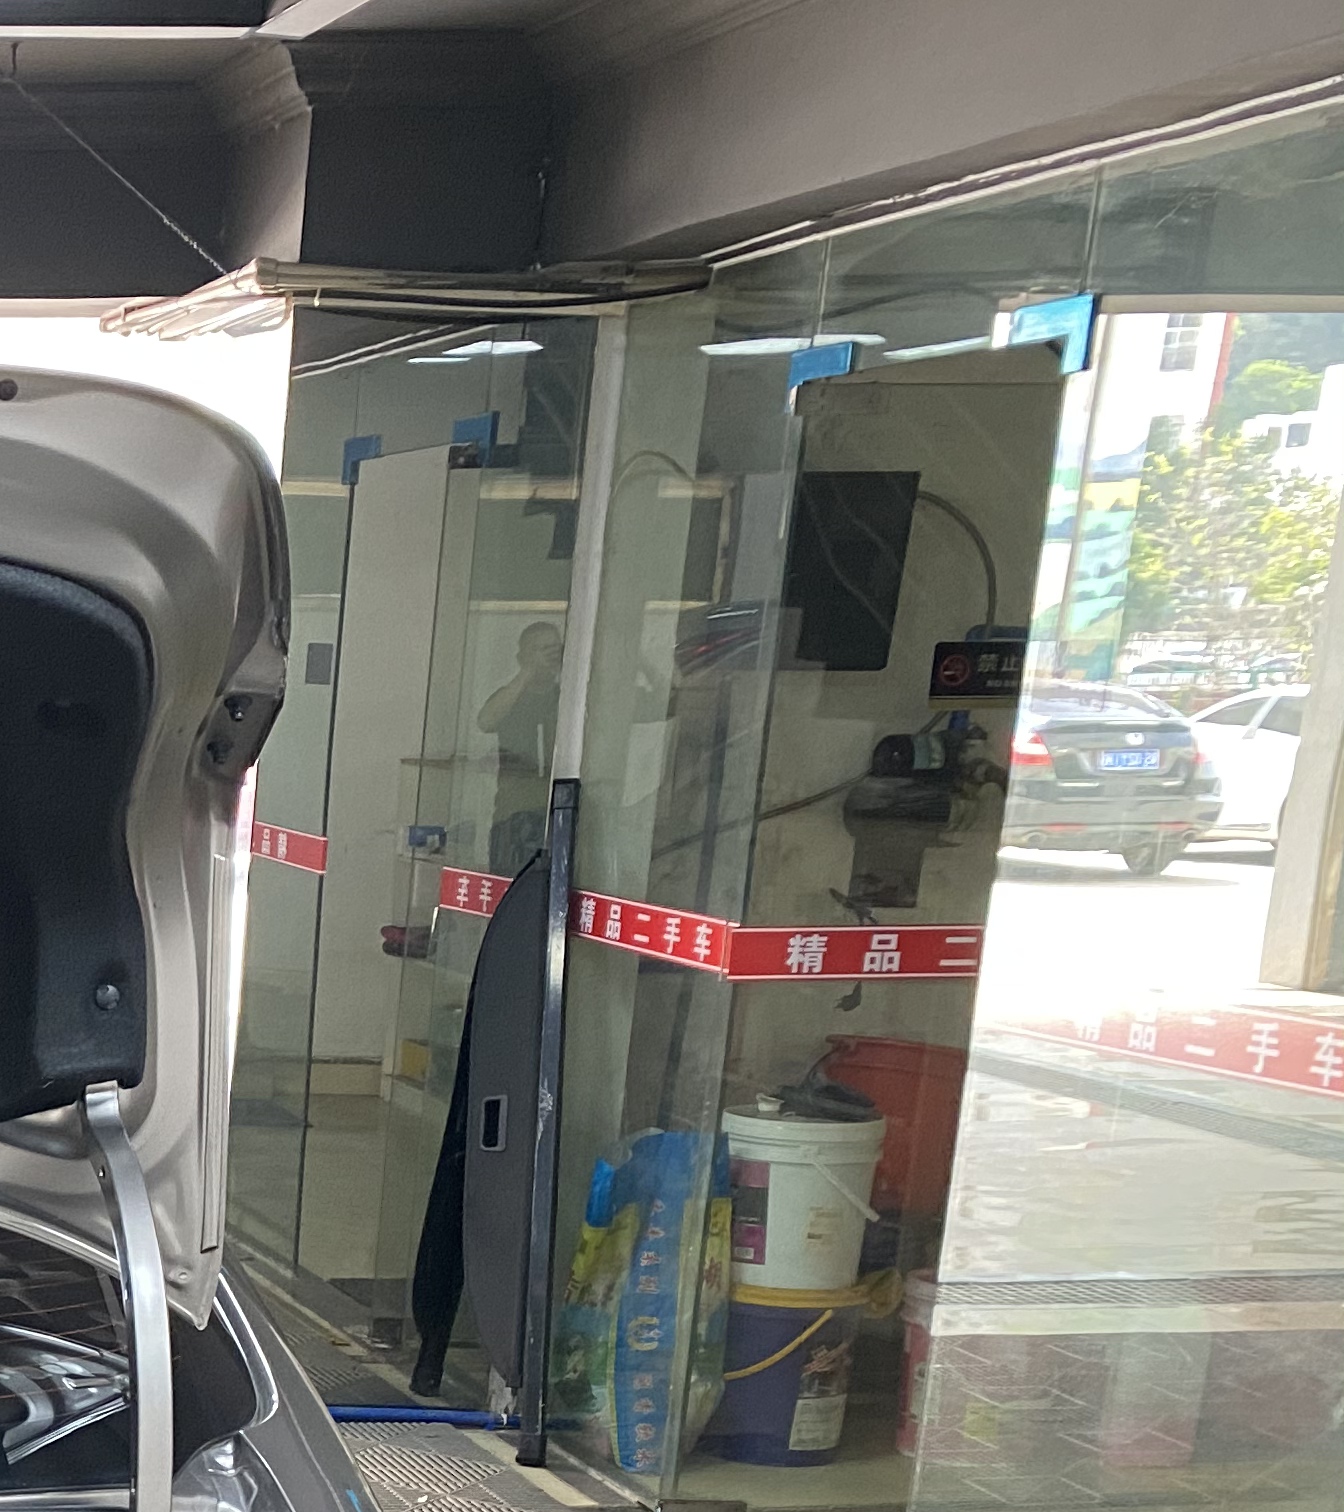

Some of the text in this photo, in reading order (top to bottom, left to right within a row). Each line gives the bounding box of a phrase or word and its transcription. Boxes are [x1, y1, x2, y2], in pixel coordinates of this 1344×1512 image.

[578, 896, 713, 962] 精品二手车
